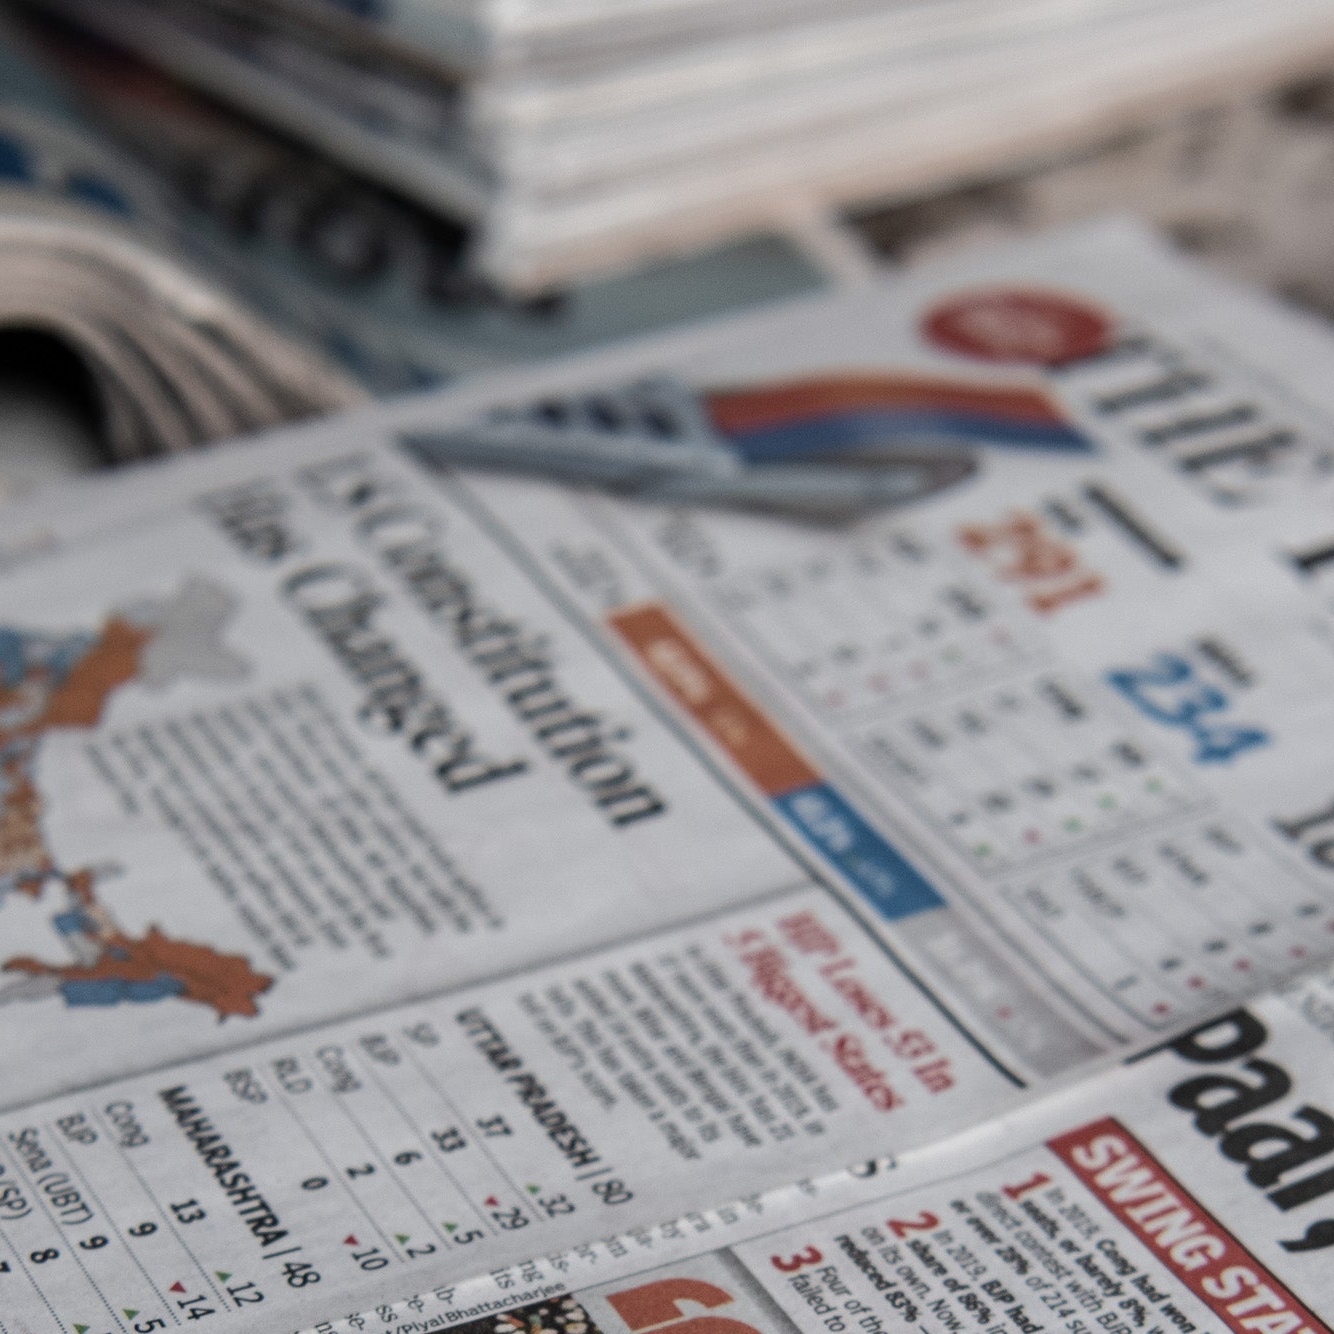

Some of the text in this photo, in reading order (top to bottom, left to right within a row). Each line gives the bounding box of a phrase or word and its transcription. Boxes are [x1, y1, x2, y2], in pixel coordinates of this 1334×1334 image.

[1107, 654, 1270, 766] 234
[103, 1101, 150, 1150] Cong
[454, 1007, 634, 1206] UTTAR PRADESH 80
[158, 1085, 320, 1289] MAHARASHTRA 48
[1071, 1135, 1225, 1271] SWING
[444, 1282, 566, 1323] Bhattacharjee
